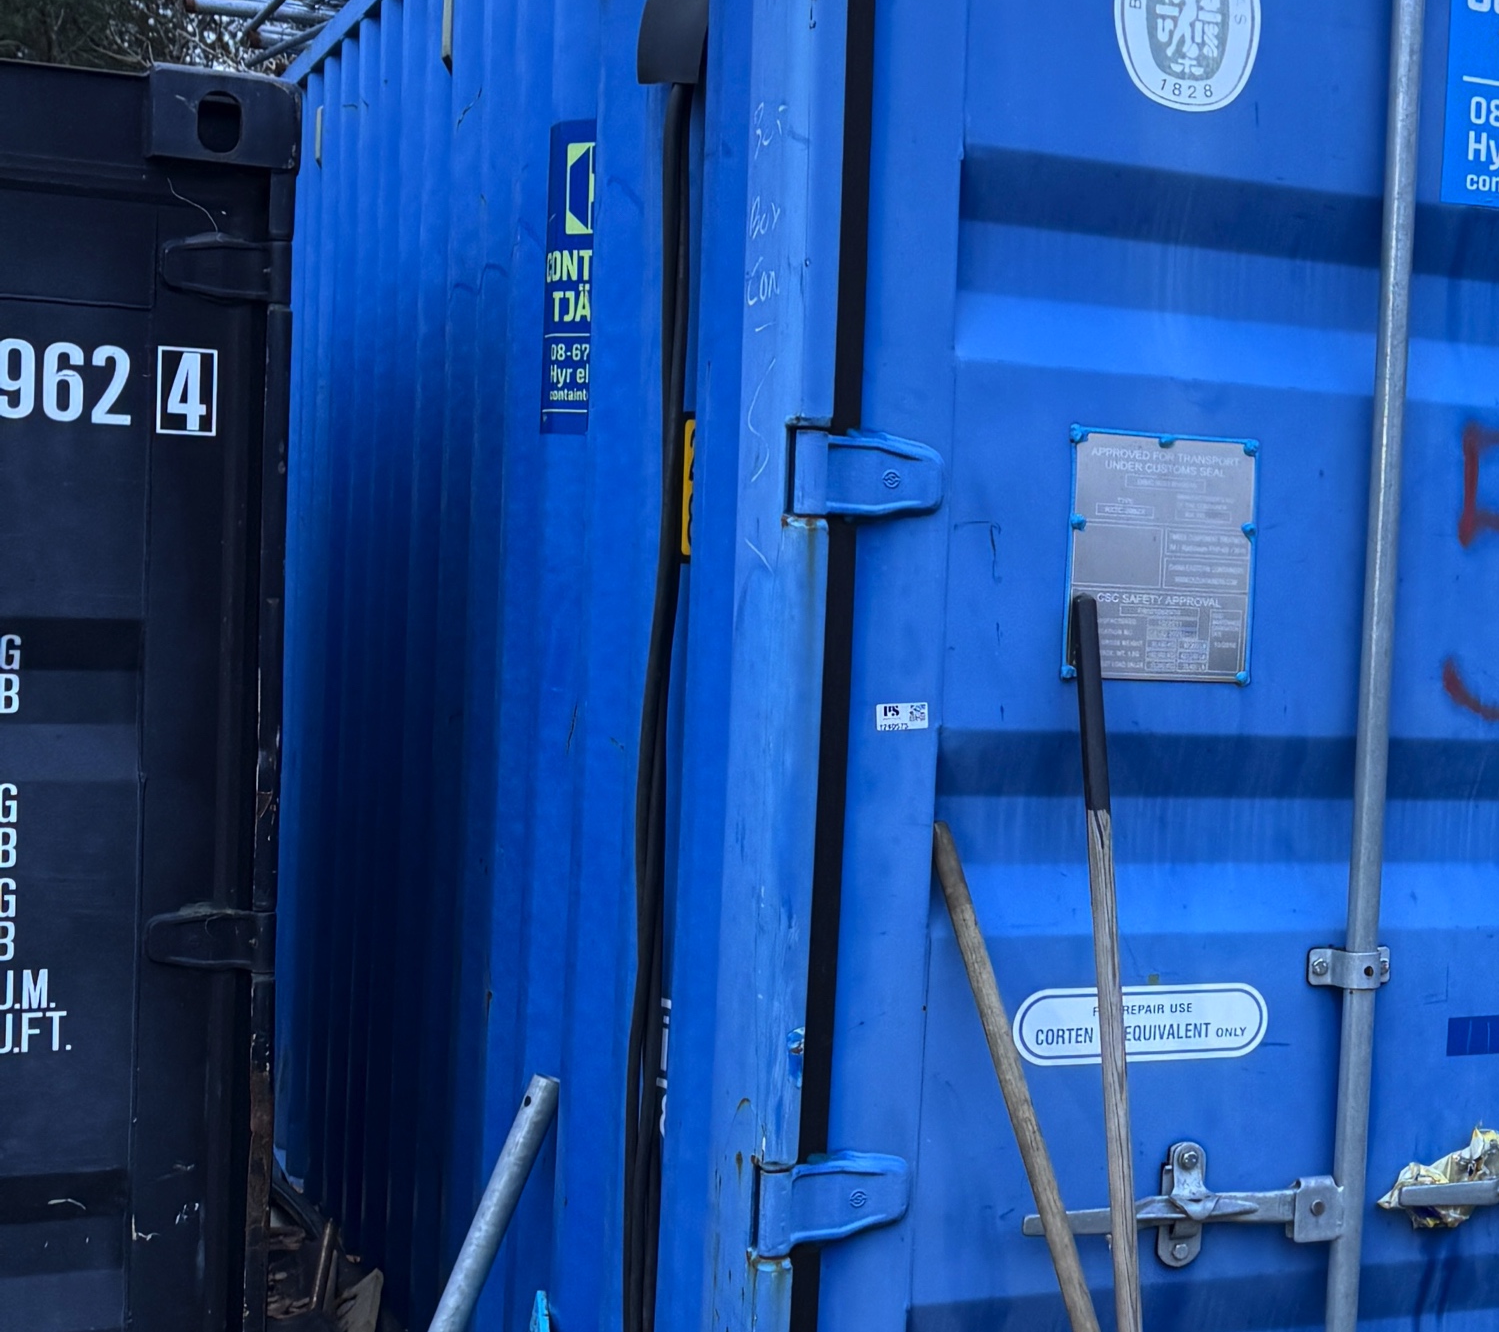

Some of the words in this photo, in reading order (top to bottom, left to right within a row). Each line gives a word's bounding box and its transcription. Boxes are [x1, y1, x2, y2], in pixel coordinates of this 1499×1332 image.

[1160, 79, 1213, 98] 1828
[553, 283, 591, 322] TJÄ
[551, 343, 590, 361] 08-67
[0, 338, 131, 426] 962
[167, 352, 207, 431] 4
[550, 364, 573, 387] Hyr
[576, 363, 589, 383] el
[1091, 447, 1150, 460] APPROVED
[1152, 450, 1175, 462] FOR
[1178, 453, 1240, 467] TRANSPORT
[1105, 460, 1142, 472] UNDER
[1144, 463, 1197, 475] CUSTOMS
[1200, 467, 1225, 477] SEAL
[1096, 592, 1120, 603] CSC
[1122, 594, 1163, 605] SAFETY
[1165, 596, 1221, 607] APPROVAL
[1122, 1003, 1165, 1016] REPAIR
[1170, 1002, 1193, 1014] USE
[1035, 1027, 1094, 1046] CORTEN
[1124, 1022, 1211, 1042] EQUIVALENT
[1215, 1026, 1247, 1038] ONLY
